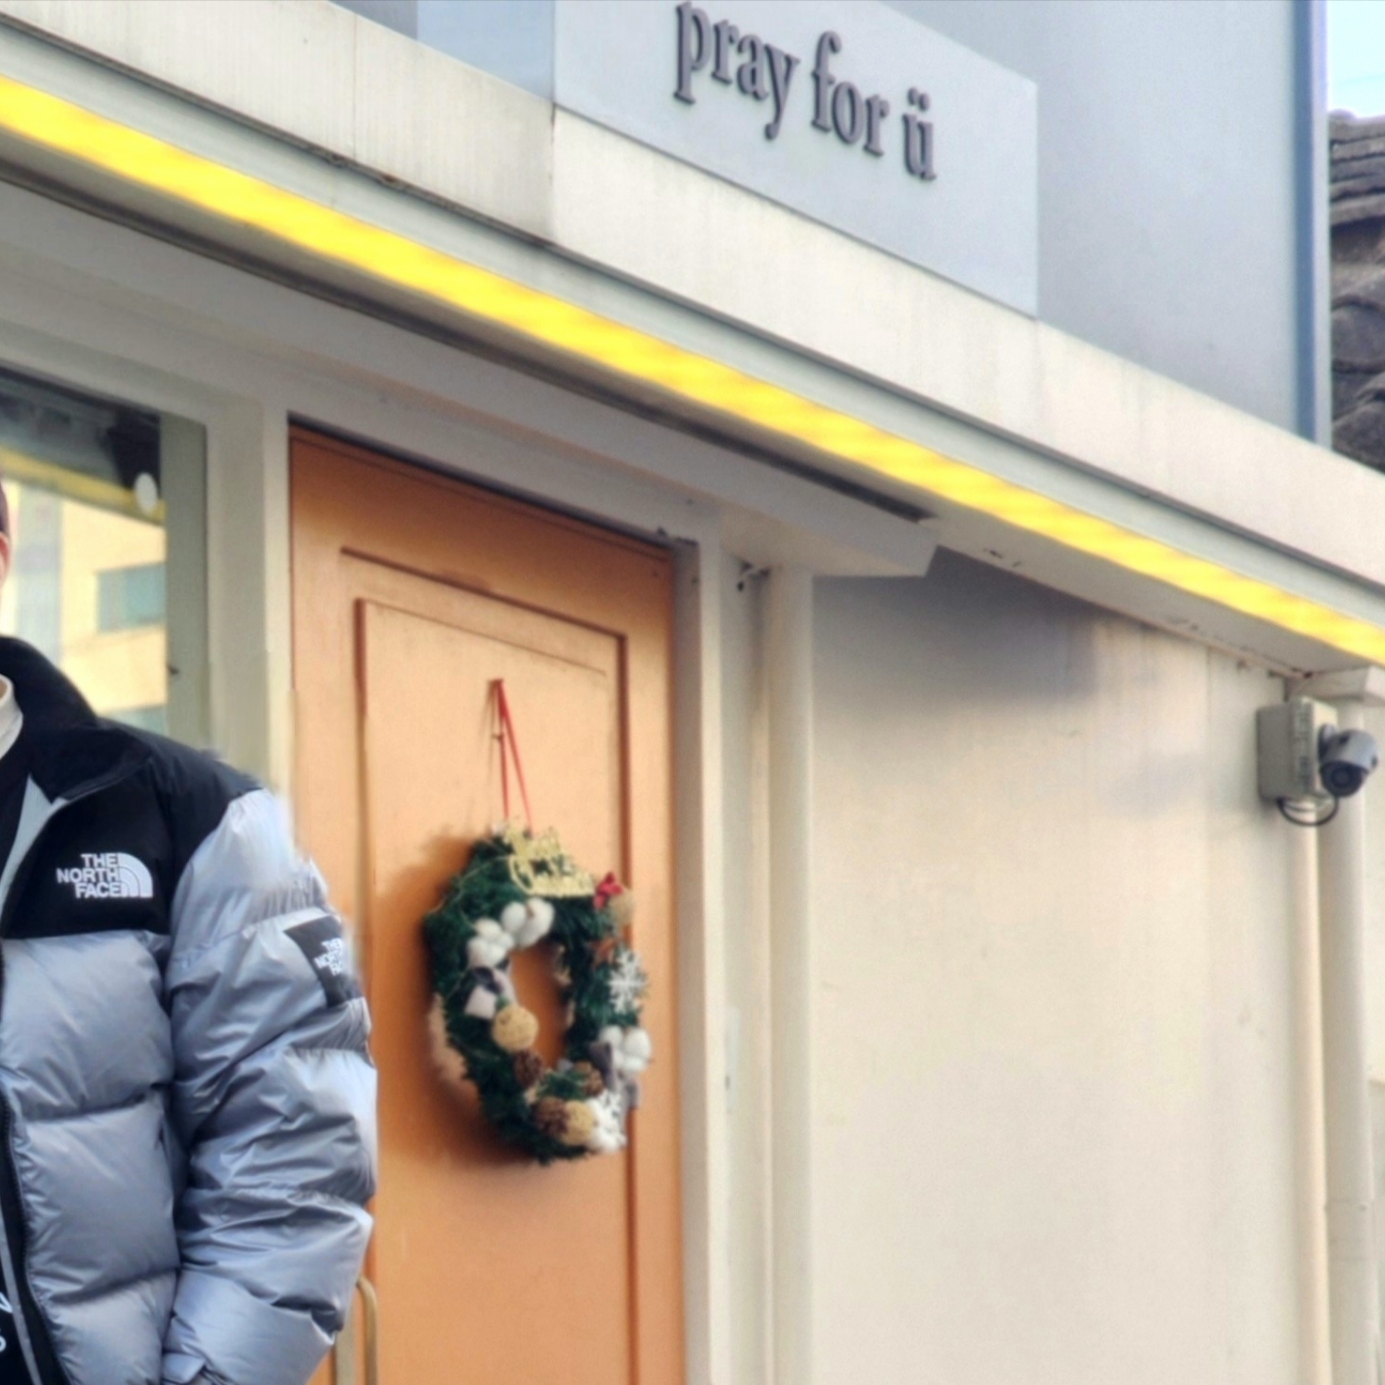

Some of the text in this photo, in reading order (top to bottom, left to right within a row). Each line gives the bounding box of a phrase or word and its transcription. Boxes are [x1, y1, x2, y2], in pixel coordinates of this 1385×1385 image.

[673, 1, 936, 181] pray for ü
[80, 853, 118, 868] THE
[56, 867, 119, 883] NORTH
[75, 882, 121, 898] FACE
